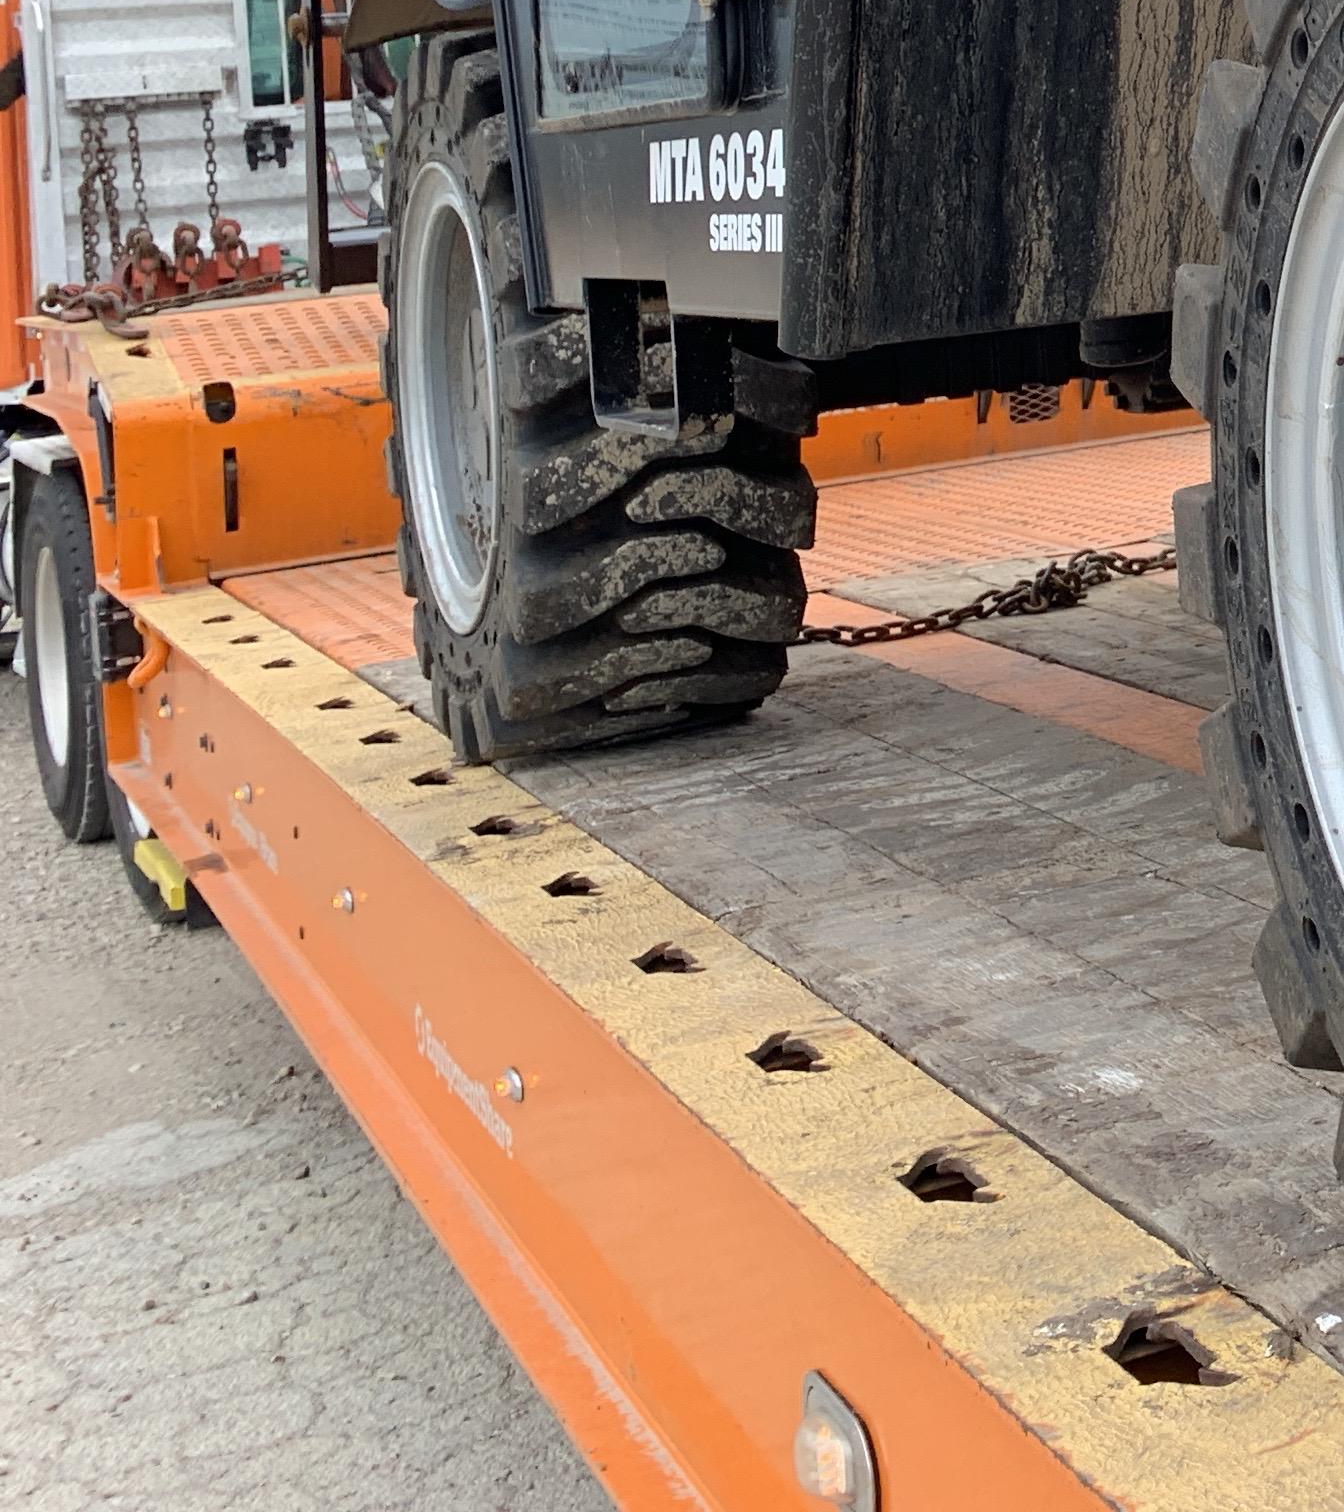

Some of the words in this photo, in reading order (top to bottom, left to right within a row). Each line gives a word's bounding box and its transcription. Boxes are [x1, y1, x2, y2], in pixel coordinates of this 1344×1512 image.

[650, 138, 705, 203] MTA
[709, 128, 786, 202] 6034
[709, 213, 762, 253] SERIES
[765, 214, 783, 253] III
